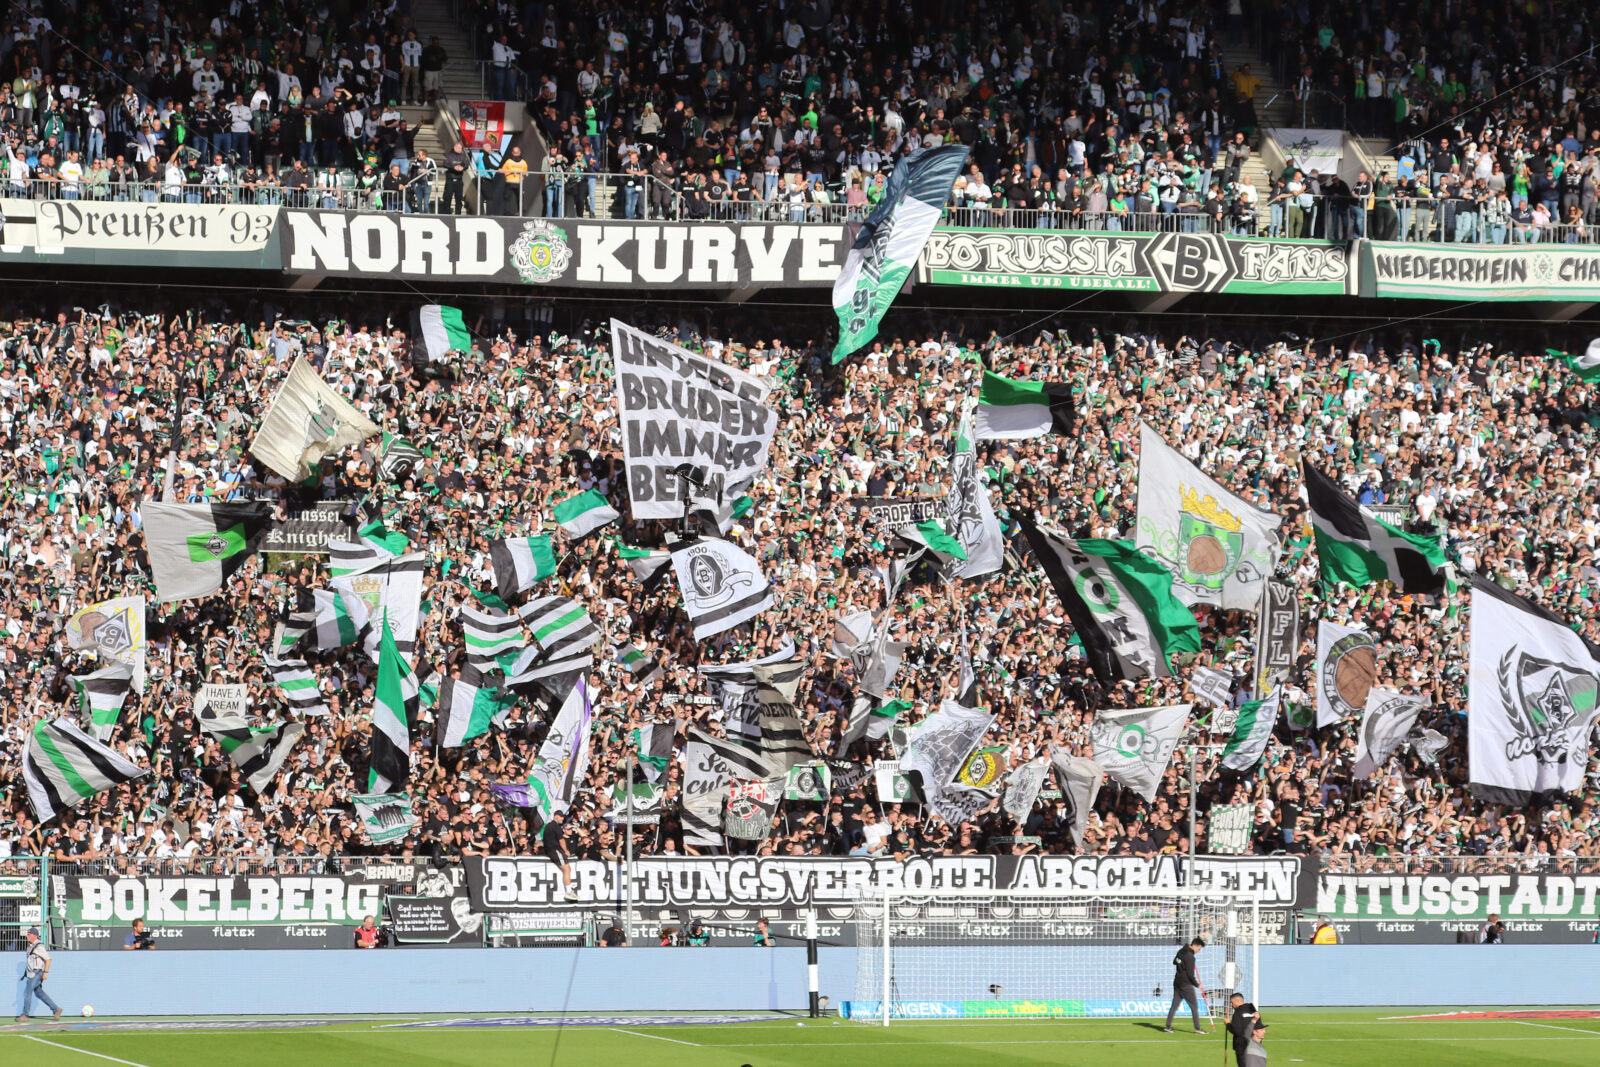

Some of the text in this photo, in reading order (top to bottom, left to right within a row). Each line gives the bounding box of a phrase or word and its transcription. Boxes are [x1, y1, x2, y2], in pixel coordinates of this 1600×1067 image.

[40, 201, 209, 245] Preußen
[287, 211, 844, 283] NORD KURVE
[924, 234, 1139, 277] BORUSSIA
[1239, 242, 1347, 283] FANS
[1376, 253, 1600, 284] NIEDERRHEIN CHA
[960, 274, 1151, 289] IMMER UND ÜBERALL!
[621, 373, 768, 437] BRÜDER
[627, 419, 763, 472] IMMER
[687, 546, 707, 558] 1900
[205, 687, 242, 699] I HAVE A
[207, 700, 240, 711] DREAM
[79, 876, 380, 921] BOKELBERG
[1316, 875, 1600, 916] VITUSSTADT
[67, 928, 110, 938] flatex
[212, 926, 256, 937] flatex
[284, 926, 327, 937] flatex
[959, 923, 1011, 936] flatex
[1042, 923, 1094, 936] flatex
[1125, 923, 1177, 936] flatex
[1376, 922, 1415, 932] flatex
[1440, 922, 1480, 932] flatex
[1505, 922, 1543, 932] flatex
